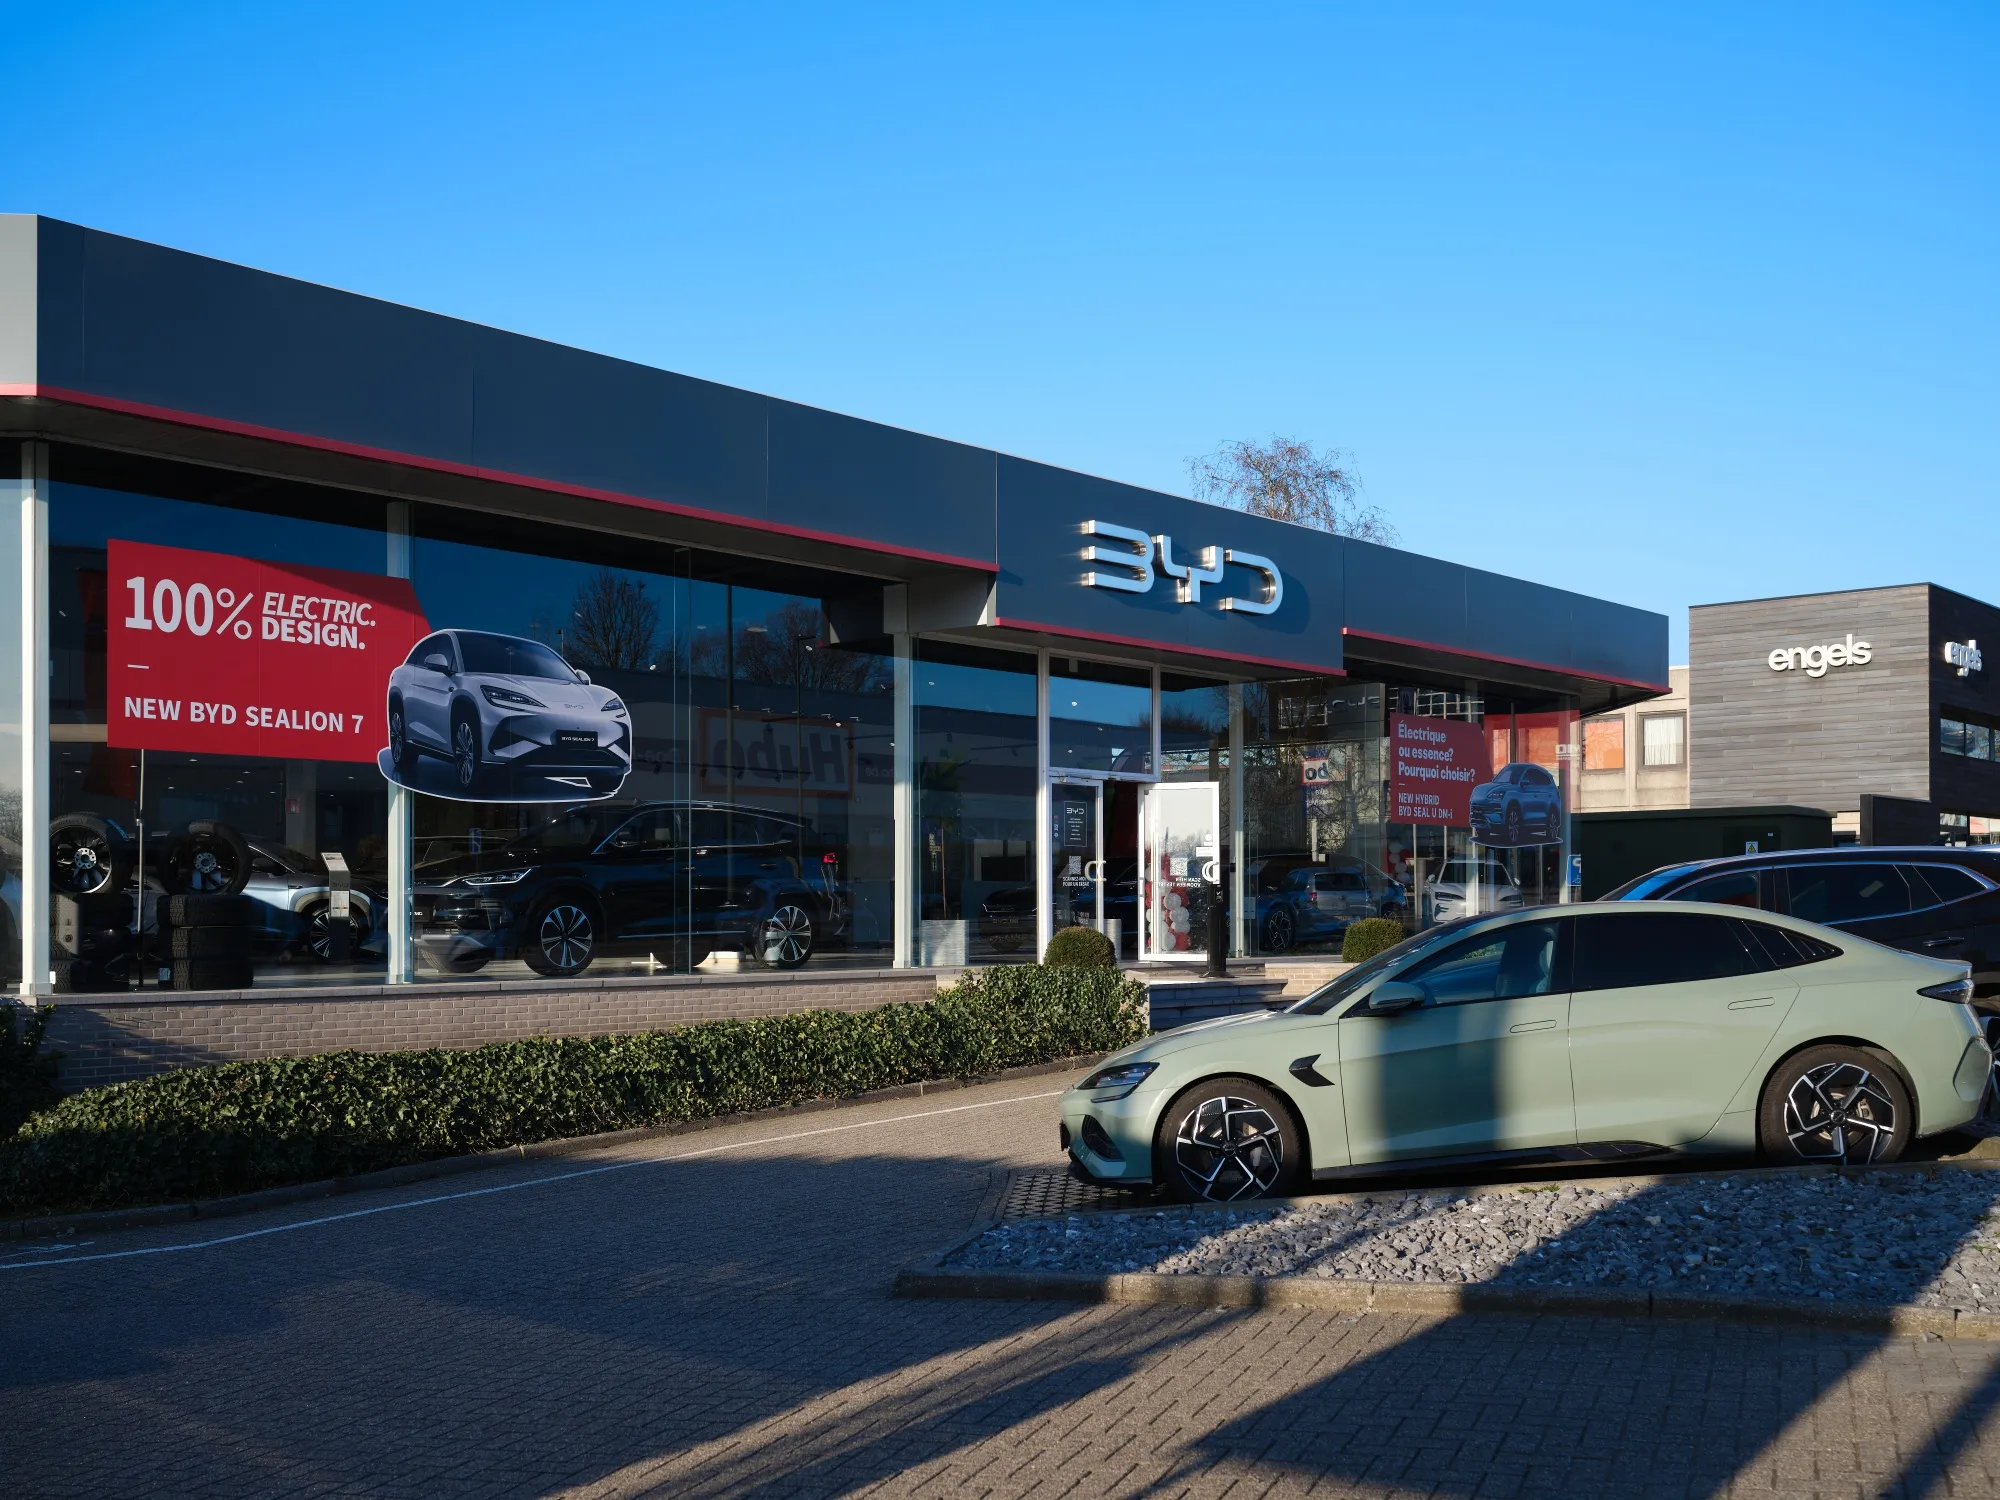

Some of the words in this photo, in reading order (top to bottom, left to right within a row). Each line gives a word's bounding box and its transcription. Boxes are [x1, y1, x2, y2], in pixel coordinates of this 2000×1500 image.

[1084, 520, 1284, 615] BYD
[124, 575, 254, 640] 100%
[261, 591, 377, 627] ELECTRIC.
[261, 615, 366, 650] DESIGN.
[1768, 633, 1873, 678] engels
[1944, 639, 1983, 677] engels
[124, 696, 182, 722] NEW
[189, 702, 237, 725] BYD
[246, 705, 344, 733] SEALION
[351, 714, 364, 735] 7
[1398, 720, 1447, 743] Électrique
[1398, 747, 1410, 757] ou
[1411, 747, 1454, 763] essence?
[1398, 762, 1439, 780] Pourquoi
[1440, 768, 1476, 783] choisir?
[1398, 793, 1413, 804] NEW
[1415, 794, 1440, 806] HYBRID
[1398, 805, 1412, 817] BYD
[1413, 806, 1431, 818] SEAL
[1432, 807, 1438, 818] U
